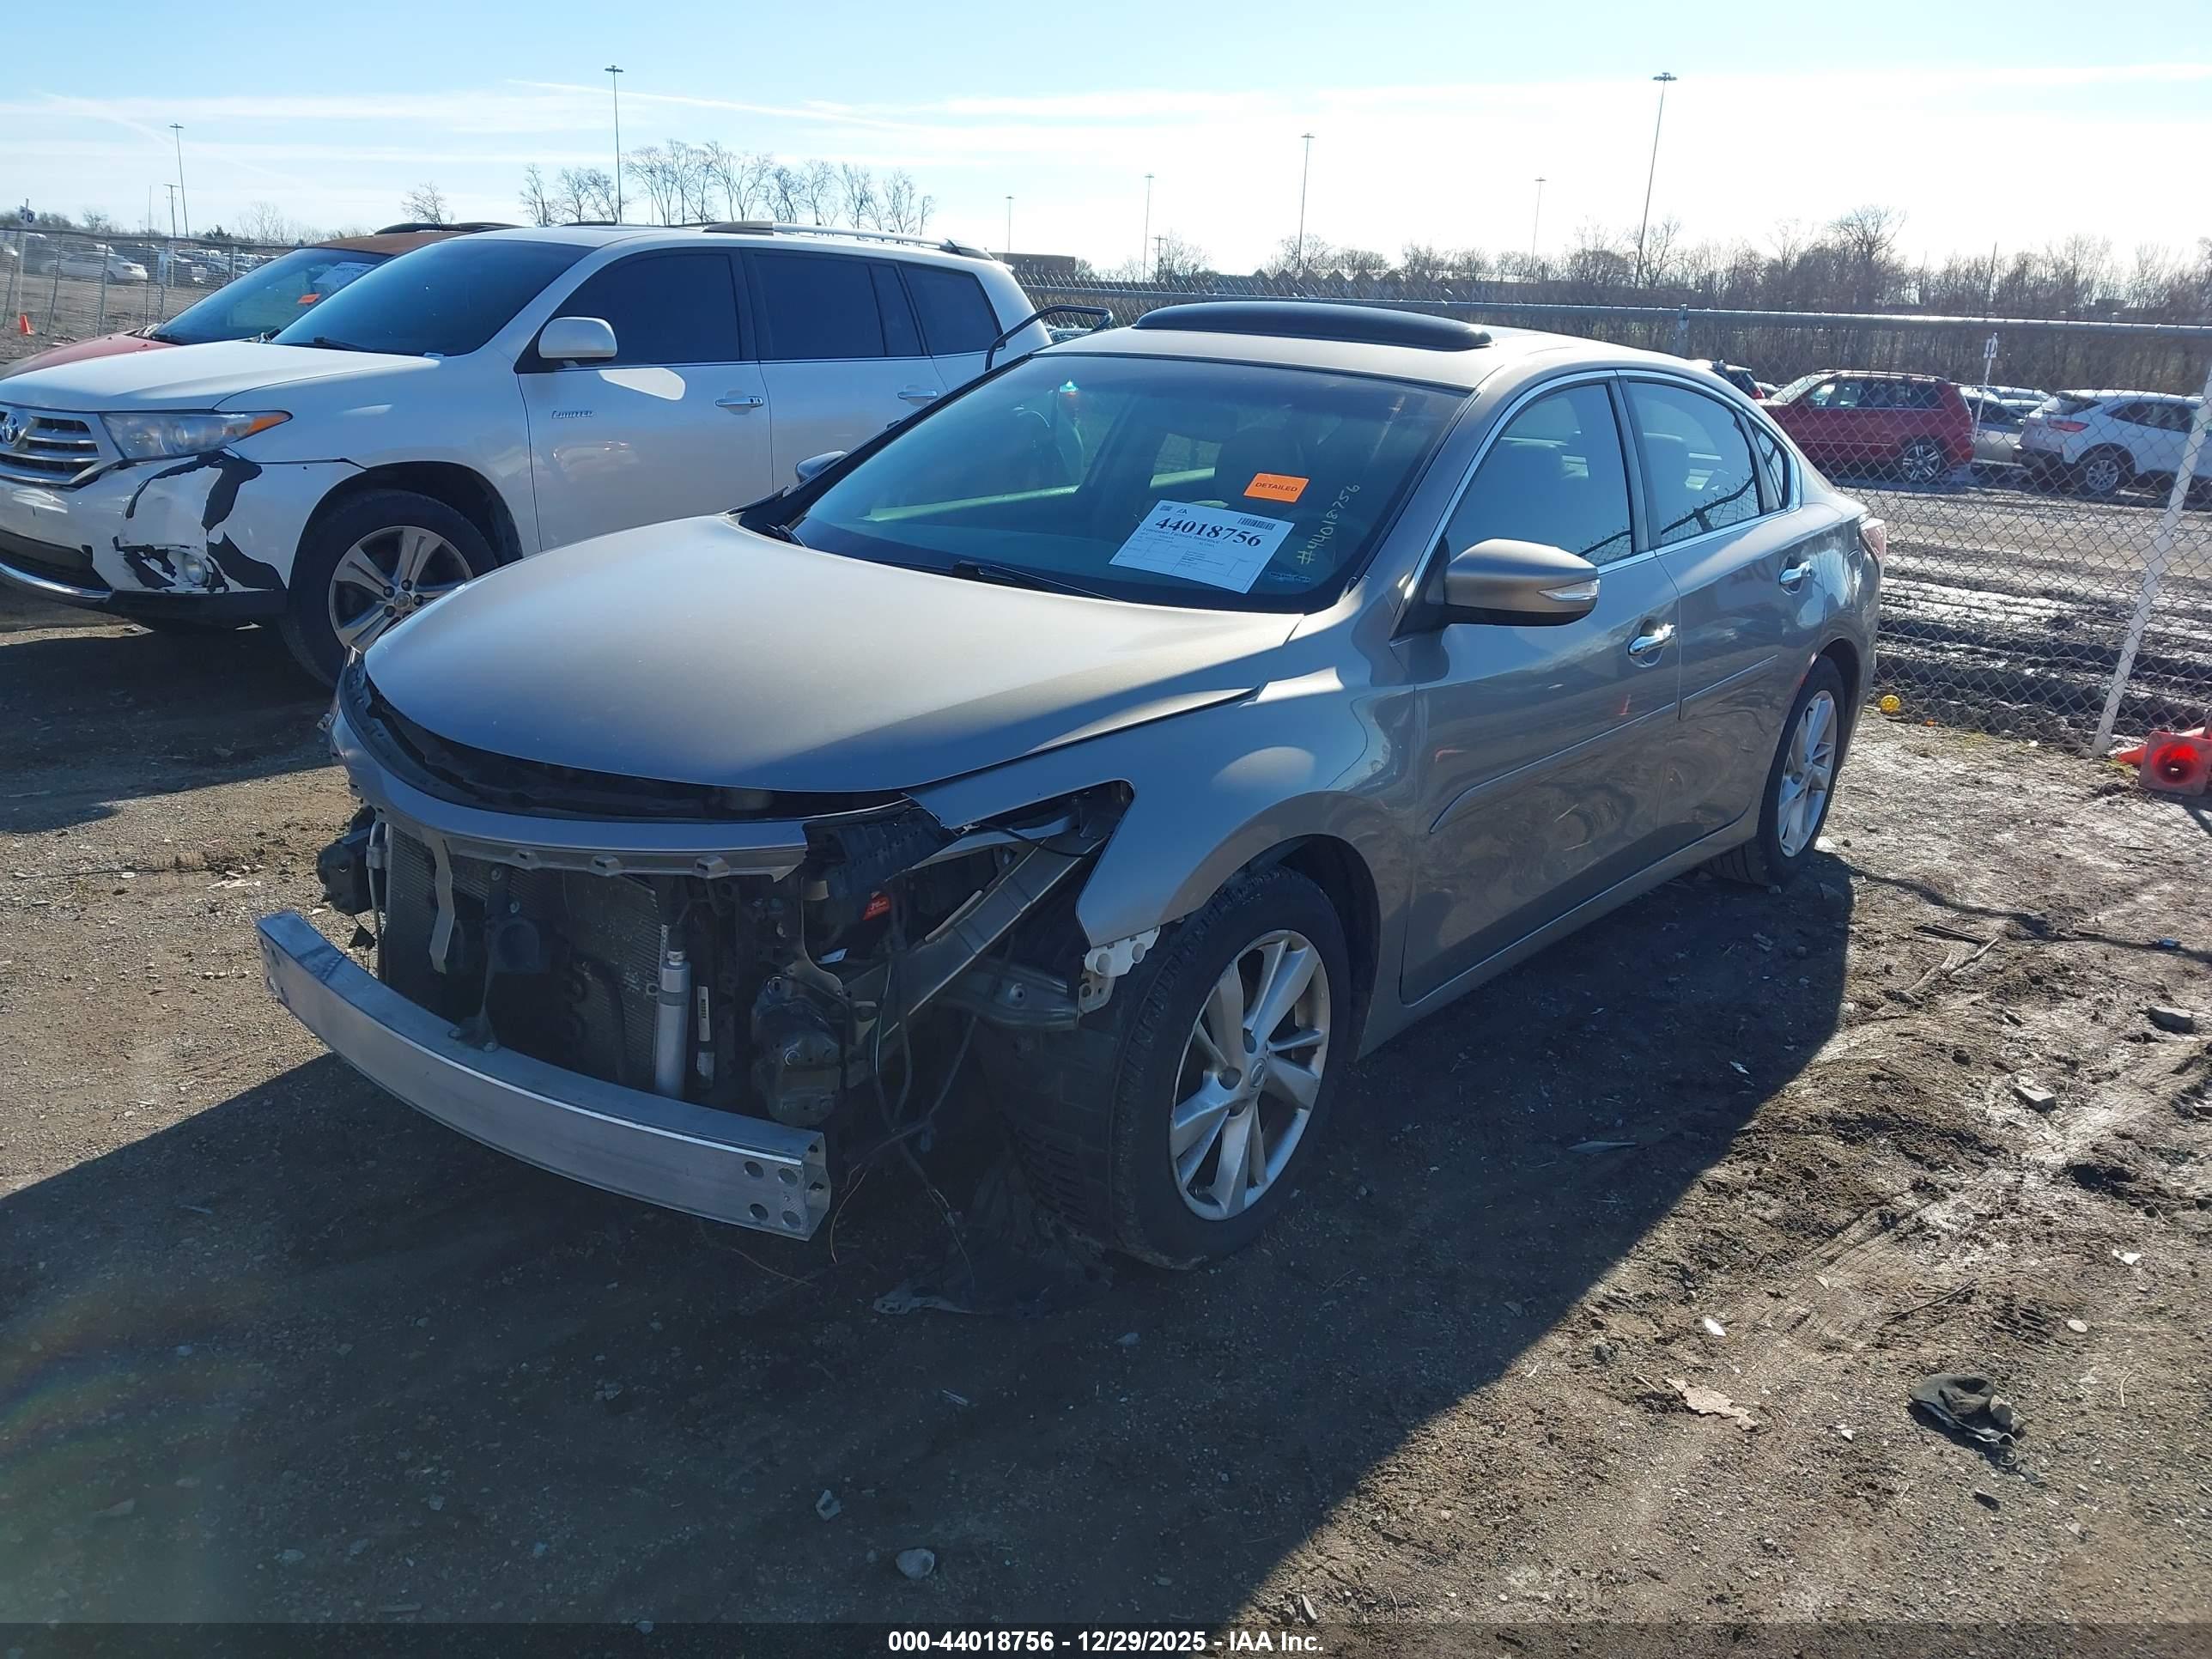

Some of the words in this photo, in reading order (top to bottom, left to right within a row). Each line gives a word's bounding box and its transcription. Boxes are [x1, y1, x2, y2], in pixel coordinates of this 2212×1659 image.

[1255, 482, 1298, 493] DETAILED
[1156, 517, 1267, 547] 44018756
[1297, 484, 1360, 564] #44018756
